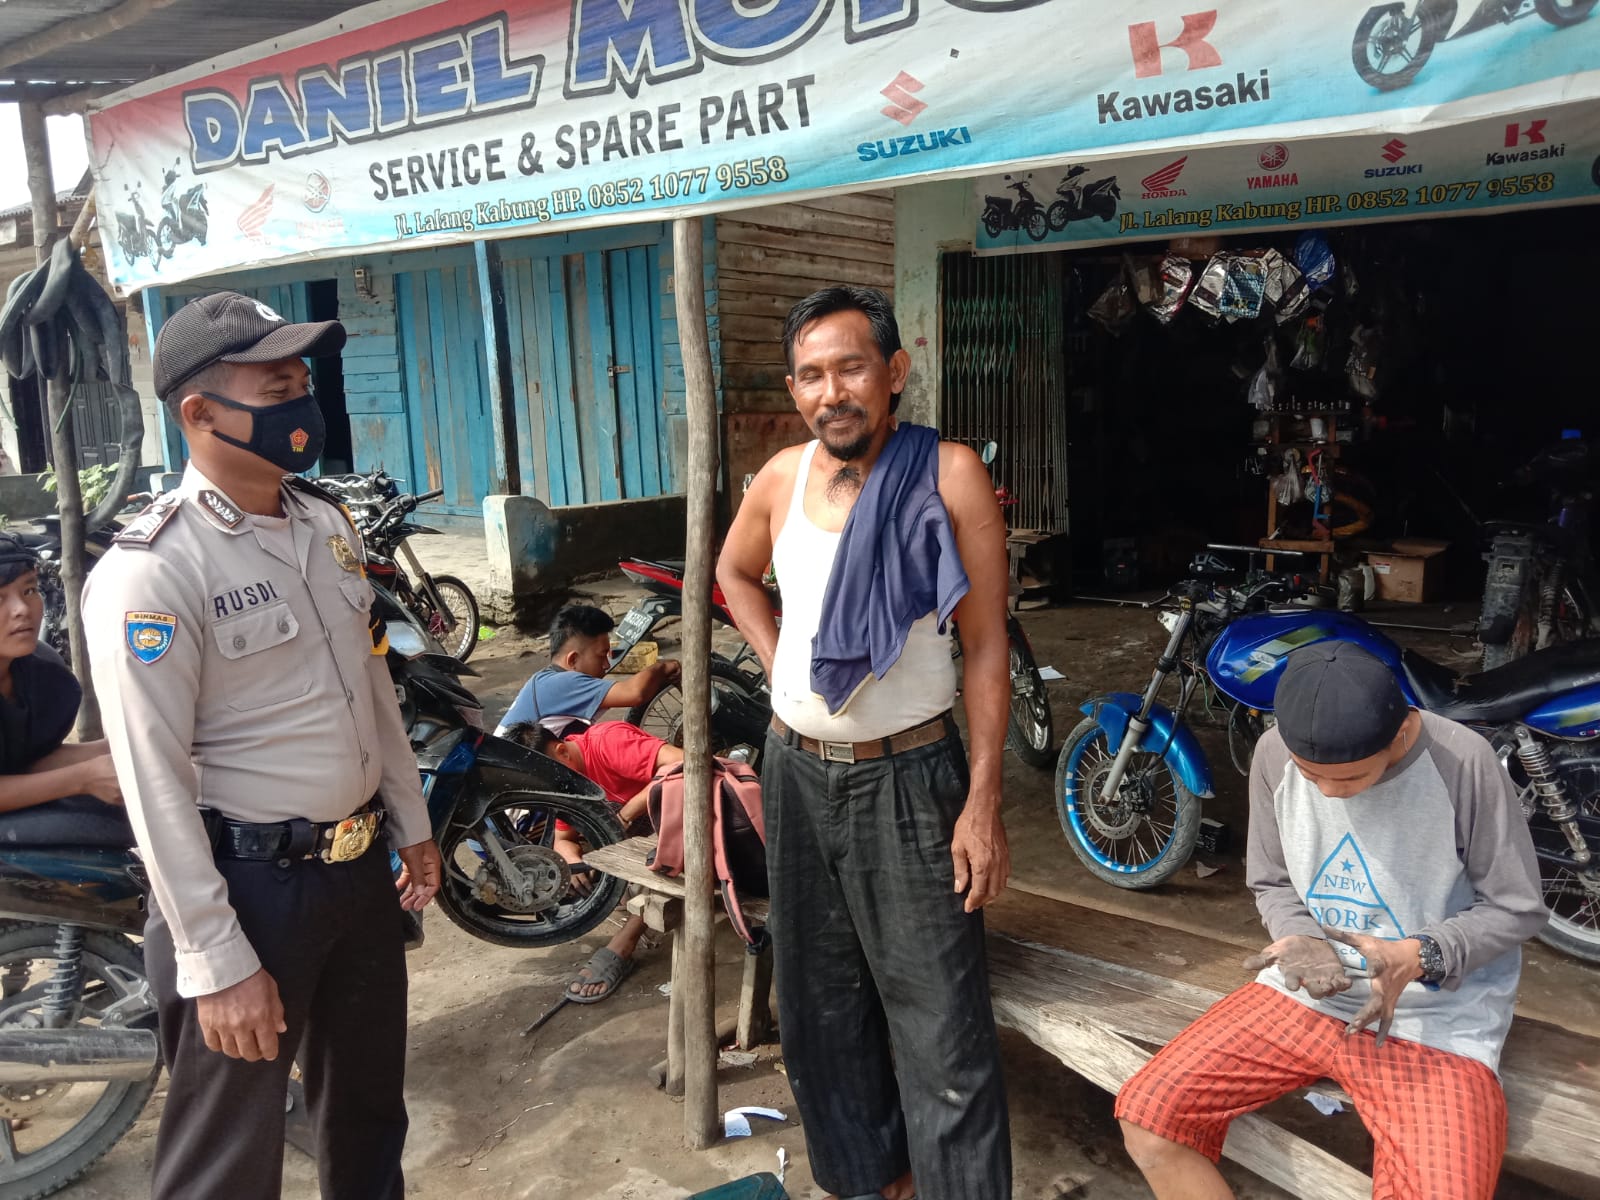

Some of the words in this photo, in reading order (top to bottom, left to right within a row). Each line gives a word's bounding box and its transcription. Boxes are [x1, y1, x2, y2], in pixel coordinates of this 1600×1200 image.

[182, 11, 545, 175] DANIEL
[1097, 69, 1270, 124] Kawasaki
[369, 138, 506, 201] SERVICE
[518, 132, 544, 176] &
[555, 102, 684, 170] SPARE
[699, 74, 815, 145] PART
[857, 126, 972, 161] SUZUKI
[1486, 143, 1566, 167] Kawasaki
[1247, 172, 1299, 190] YAMAHA
[1364, 164, 1423, 179] SUZUKI
[394, 213, 413, 240] Jl.
[414, 208, 475, 232] Lalang
[475, 197, 551, 222] Kabung
[552, 187, 586, 214] HP.
[588, 177, 645, 210] 0852
[649, 166, 710, 201] 1077
[716, 155, 790, 191] 9558
[1119, 212, 1139, 233] Jl.
[1143, 208, 1213, 227] Lalang
[1215, 201, 1301, 221] Kabung
[1306, 195, 1342, 215] HP.
[1347, 187, 1409, 211] 0852
[1415, 180, 1481, 205] 1077
[1486, 172, 1555, 198] 9558
[1141, 189, 1188, 199] HONDA
[213, 580, 279, 618] RUSDI
[1323, 874, 1367, 895] NEW
[1312, 907, 1382, 931] YORK
